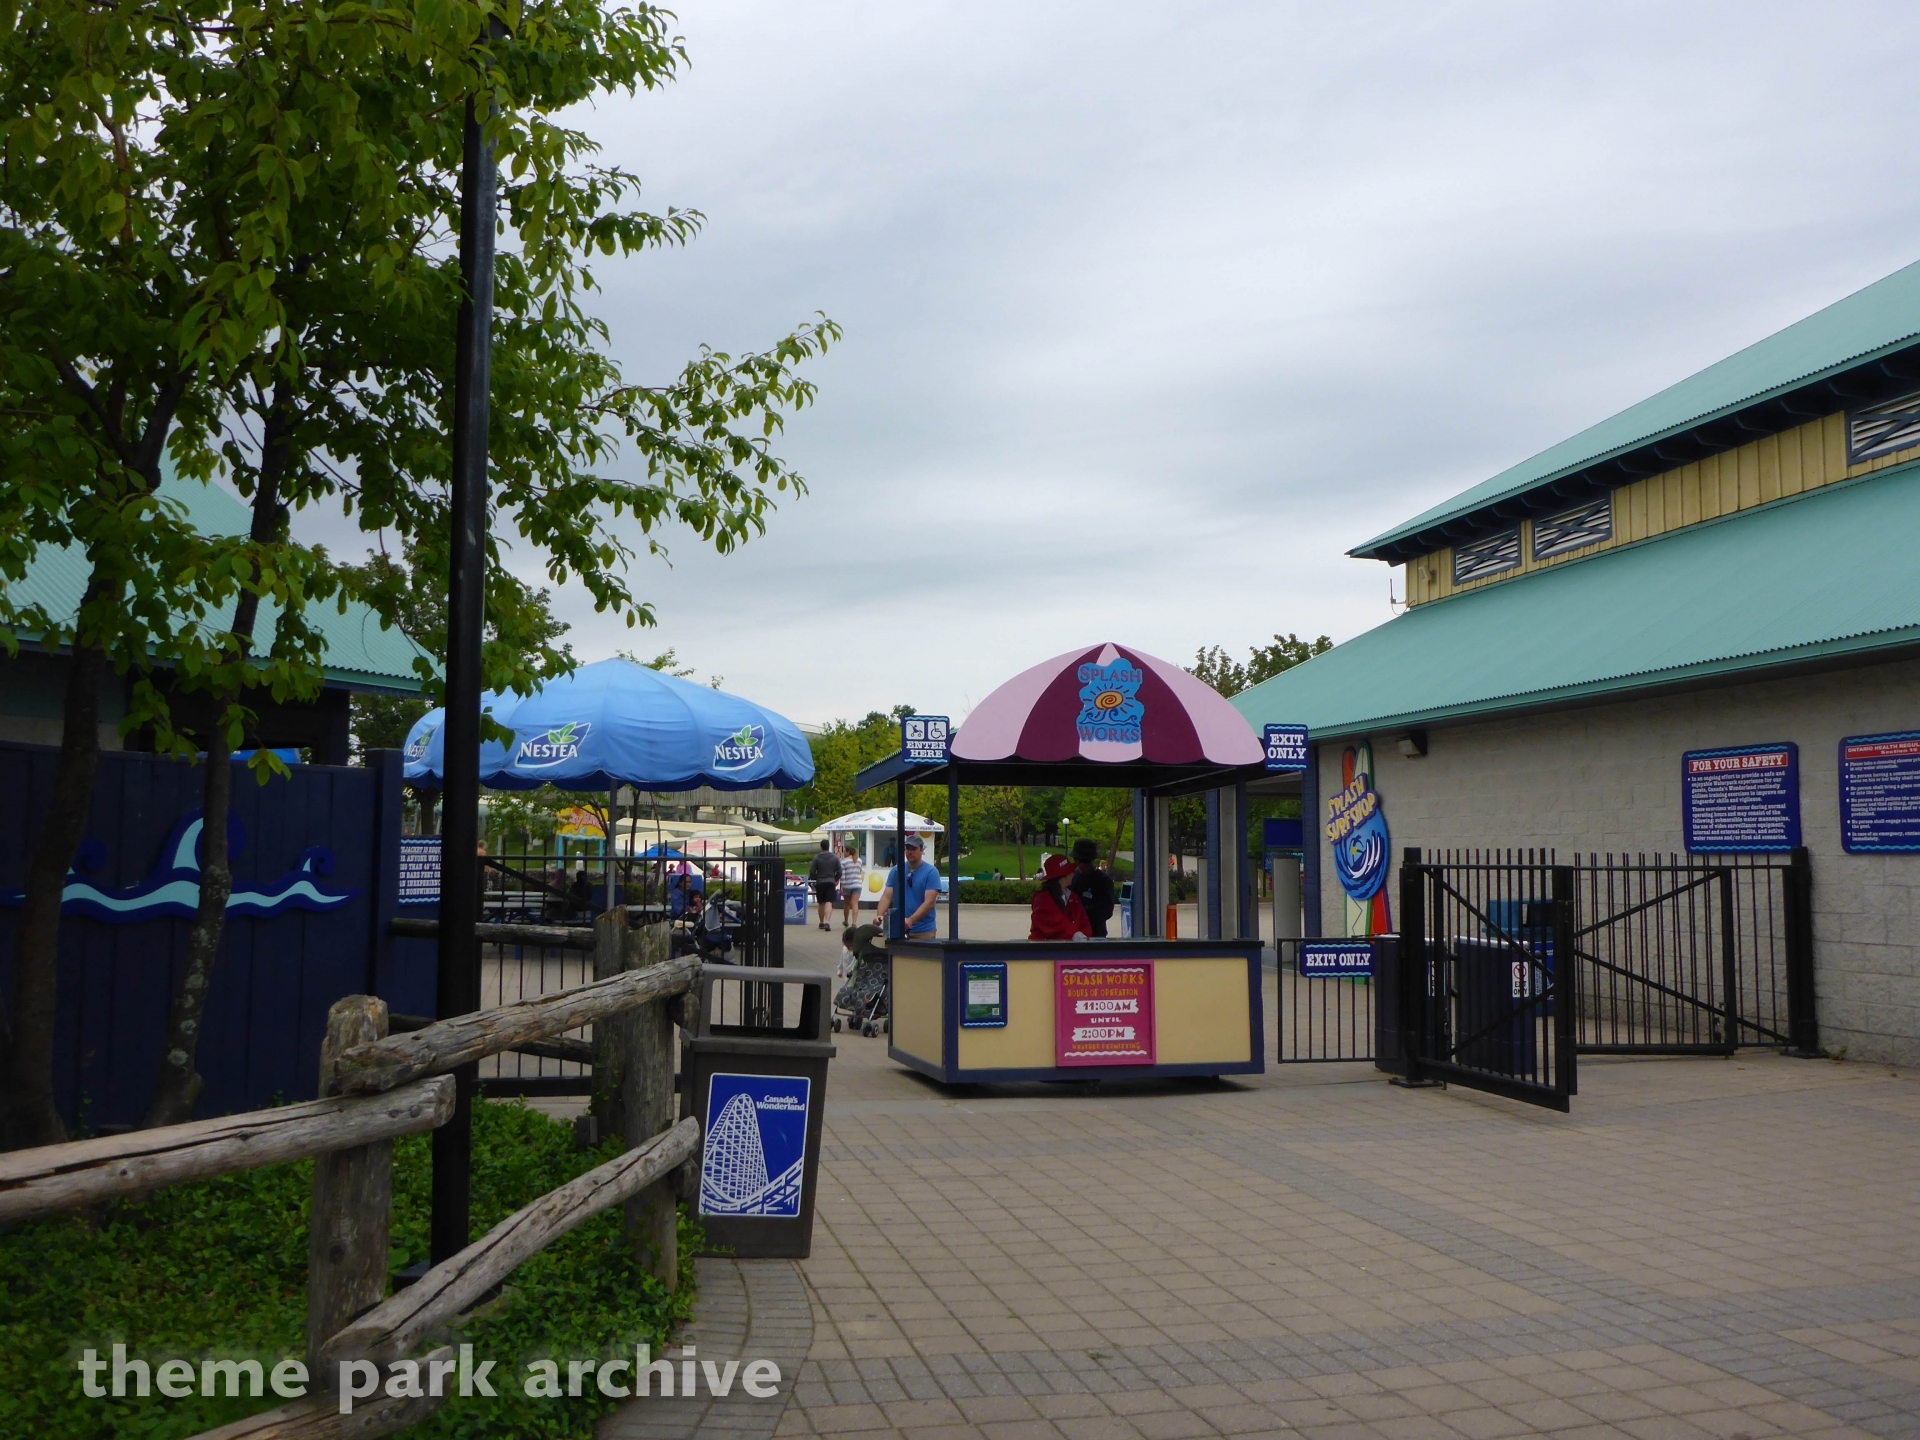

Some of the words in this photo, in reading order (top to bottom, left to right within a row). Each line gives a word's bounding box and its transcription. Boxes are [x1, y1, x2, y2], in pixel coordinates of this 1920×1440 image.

[1080, 666, 1141, 683] SPLASH
[1078, 726, 1140, 741] WORKS
[906, 741, 946, 749] ENTER
[1270, 734, 1304, 746] EXIT
[520, 743, 578, 758] NESTEA
[715, 744, 764, 760] NESTEA
[910, 750, 943, 758] HERE
[1267, 747, 1307, 759] ONLY
[1692, 760, 1711, 771] FOR
[1713, 758, 1740, 769] YOUR
[1742, 754, 1784, 768] SAFETY
[1327, 775, 1365, 819] SPLASH
[1306, 953, 1337, 967] EXIT
[1339, 953, 1371, 966] ONLY
[1063, 974, 1102, 986] SPLASH
[1106, 973, 1144, 985] WORKS
[1068, 988, 1088, 997] HOURS
[1090, 989, 1099, 997] OF
[1101, 987, 1138, 996] OPERATION
[1082, 1001, 1132, 1011] 11:00AM
[1081, 1028, 1125, 1039] 2:00PM
[764, 1094, 798, 1104] Canada's
[756, 1101, 805, 1111] Wonderland
